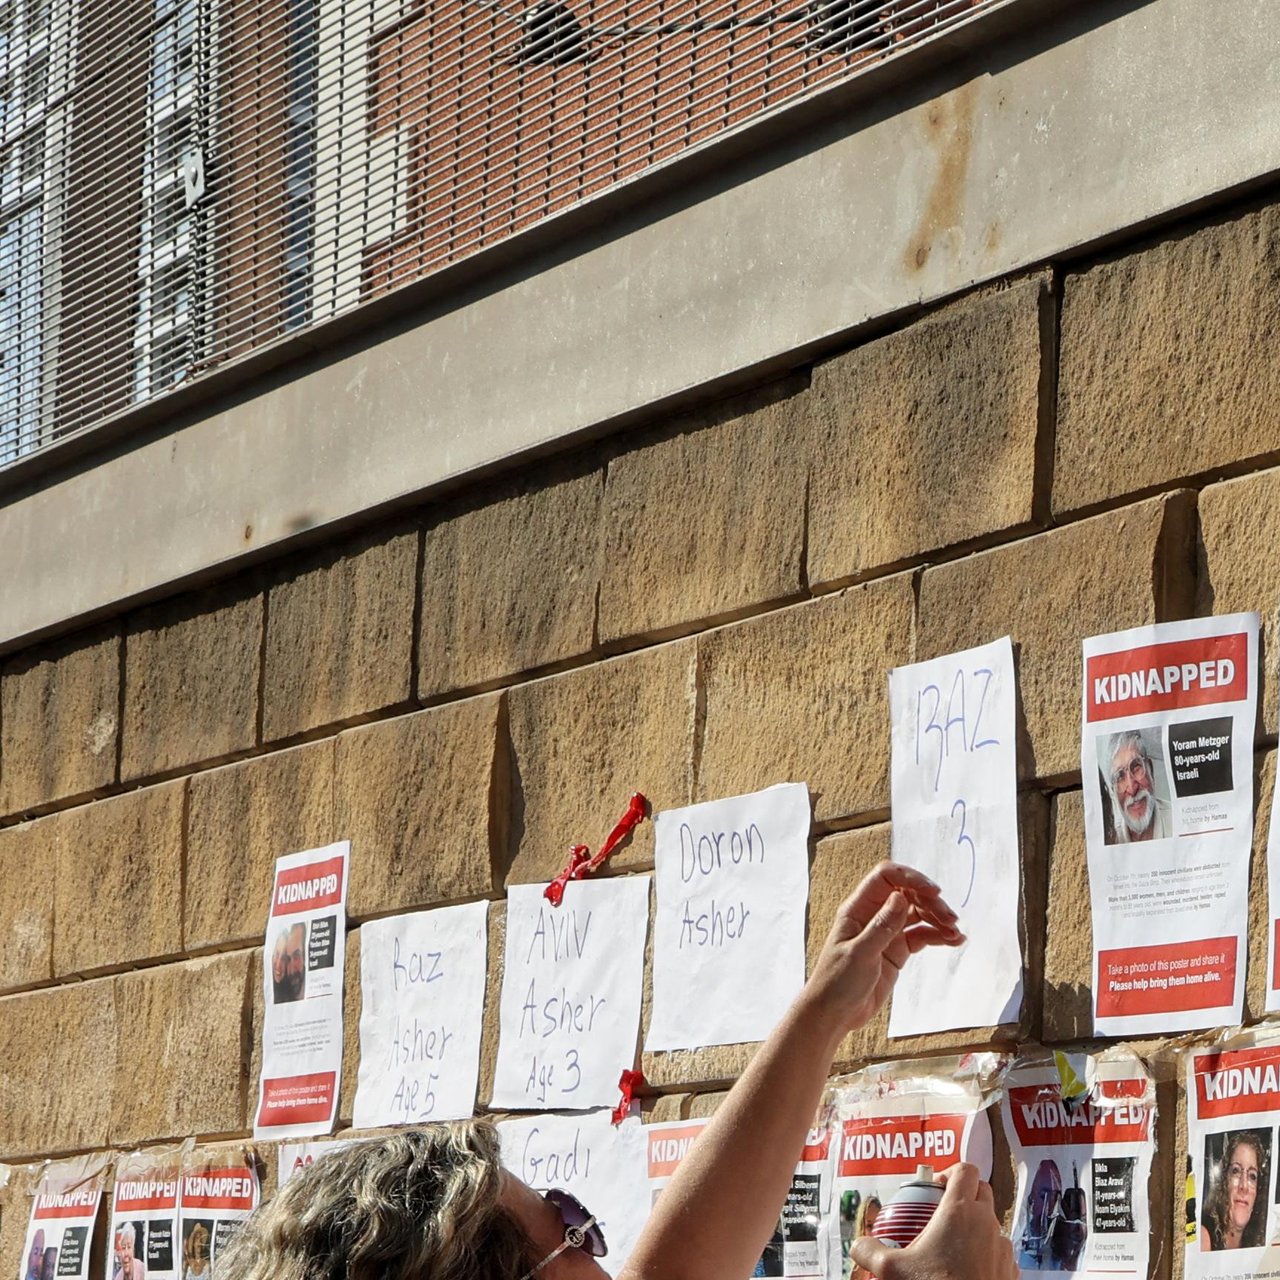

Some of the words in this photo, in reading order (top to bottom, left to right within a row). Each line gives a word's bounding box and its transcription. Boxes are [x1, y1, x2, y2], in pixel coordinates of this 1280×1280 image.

[1095, 659, 1234, 704] KIDNAPPED
[1172, 740, 1197, 751] Yoram
[1198, 736, 1229, 747] Metzger
[680, 823, 764, 882] Doron
[951, 799, 975, 908] 3
[278, 874, 337, 905] KIDNAPPED
[679, 900, 750, 949] Asher
[520, 977, 606, 1038] Asher
[388, 1014, 453, 1071] Asher
[561, 1049, 581, 1093] 3
[420, 1073, 439, 1117] 5
[523, 1128, 590, 1183] Gadi
[843, 1130, 955, 1161] KIDNAPPED
[119, 1181, 176, 1200] KIDNAPPED
[185, 1177, 251, 1197] KIDNAPPED
